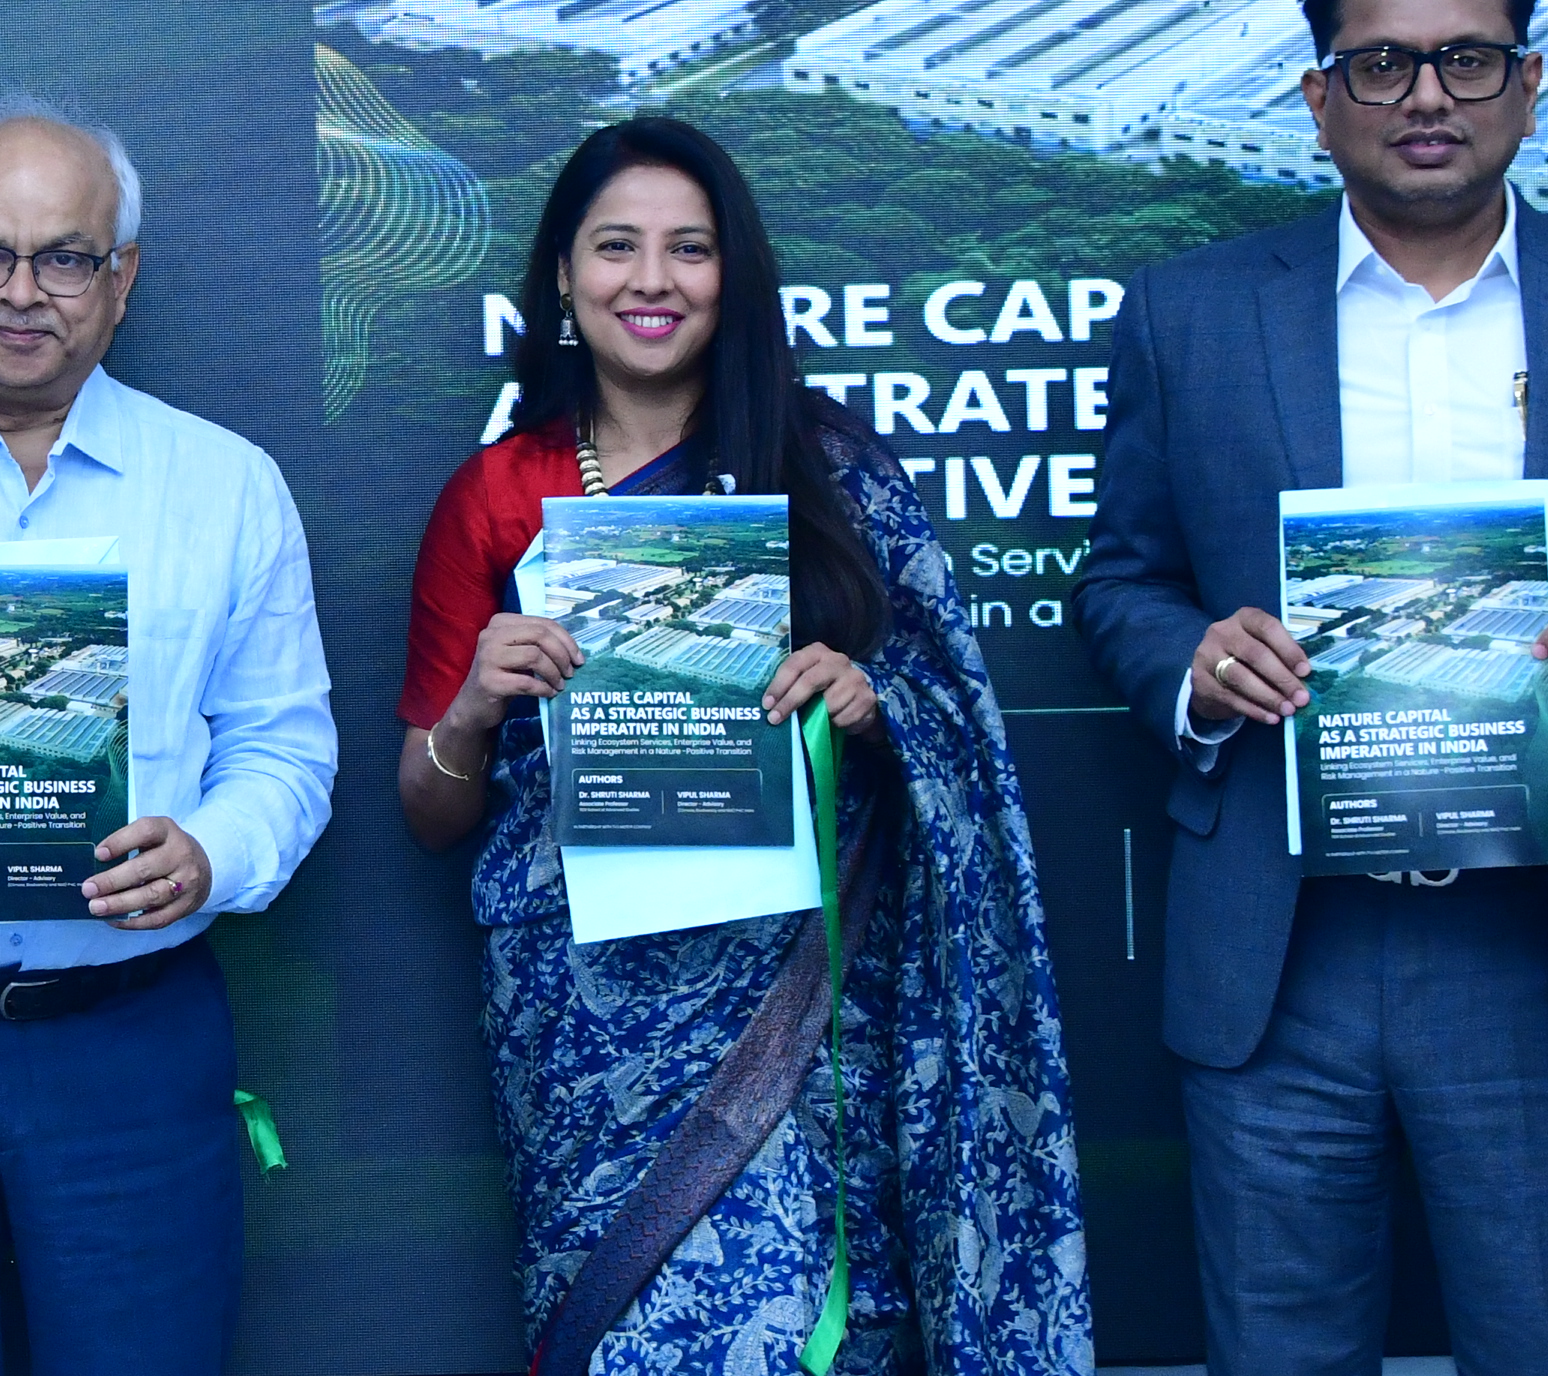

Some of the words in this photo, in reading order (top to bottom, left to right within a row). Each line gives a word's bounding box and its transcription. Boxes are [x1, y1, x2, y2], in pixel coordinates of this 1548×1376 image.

[970, 593, 1013, 628] in
[1029, 598, 1063, 627] a
[570, 692, 630, 704] NATURE
[634, 692, 694, 704] CAPITAL
[570, 708, 590, 720] AS
[594, 708, 605, 720] A
[608, 708, 687, 720] STRATEGIC
[690, 708, 761, 720] BUSINESS
[1318, 713, 1382, 728] NATURE
[1386, 709, 1451, 724] CAPITAL
[572, 723, 659, 735] IMPERATIVE
[663, 723, 679, 735] IN
[684, 723, 726, 735] INDIA
[1319, 731, 1340, 744] AS
[1344, 730, 1356, 742] A
[1360, 725, 1444, 742] STRATEGIC
[1448, 721, 1525, 737] BUSINESS
[571, 738, 597, 747] Linking
[598, 739, 639, 747] Ecosystem
[674, 739, 711, 747] Enterprise
[571, 747, 586, 755] Risk
[587, 748, 638, 757] Management
[1320, 743, 1414, 760] IMPERATIVE
[1419, 742, 1436, 754] IN
[1442, 739, 1487, 753] INDIA
[578, 775, 623, 784] AUTHORS
[23, 780, 96, 793] BUSINESS
[579, 791, 590, 799] Dr.
[590, 791, 617, 799] SHRUTI
[618, 791, 650, 799] SHARMA
[677, 791, 698, 799] VIPUL
[699, 791, 731, 799] SHARMA
[16, 797, 59, 809] INDIA
[1330, 800, 1377, 809] AUTHORS
[5, 812, 44, 821] Enterprise
[48, 821, 86, 829] Transition
[29, 865, 63, 873] SHARMA
